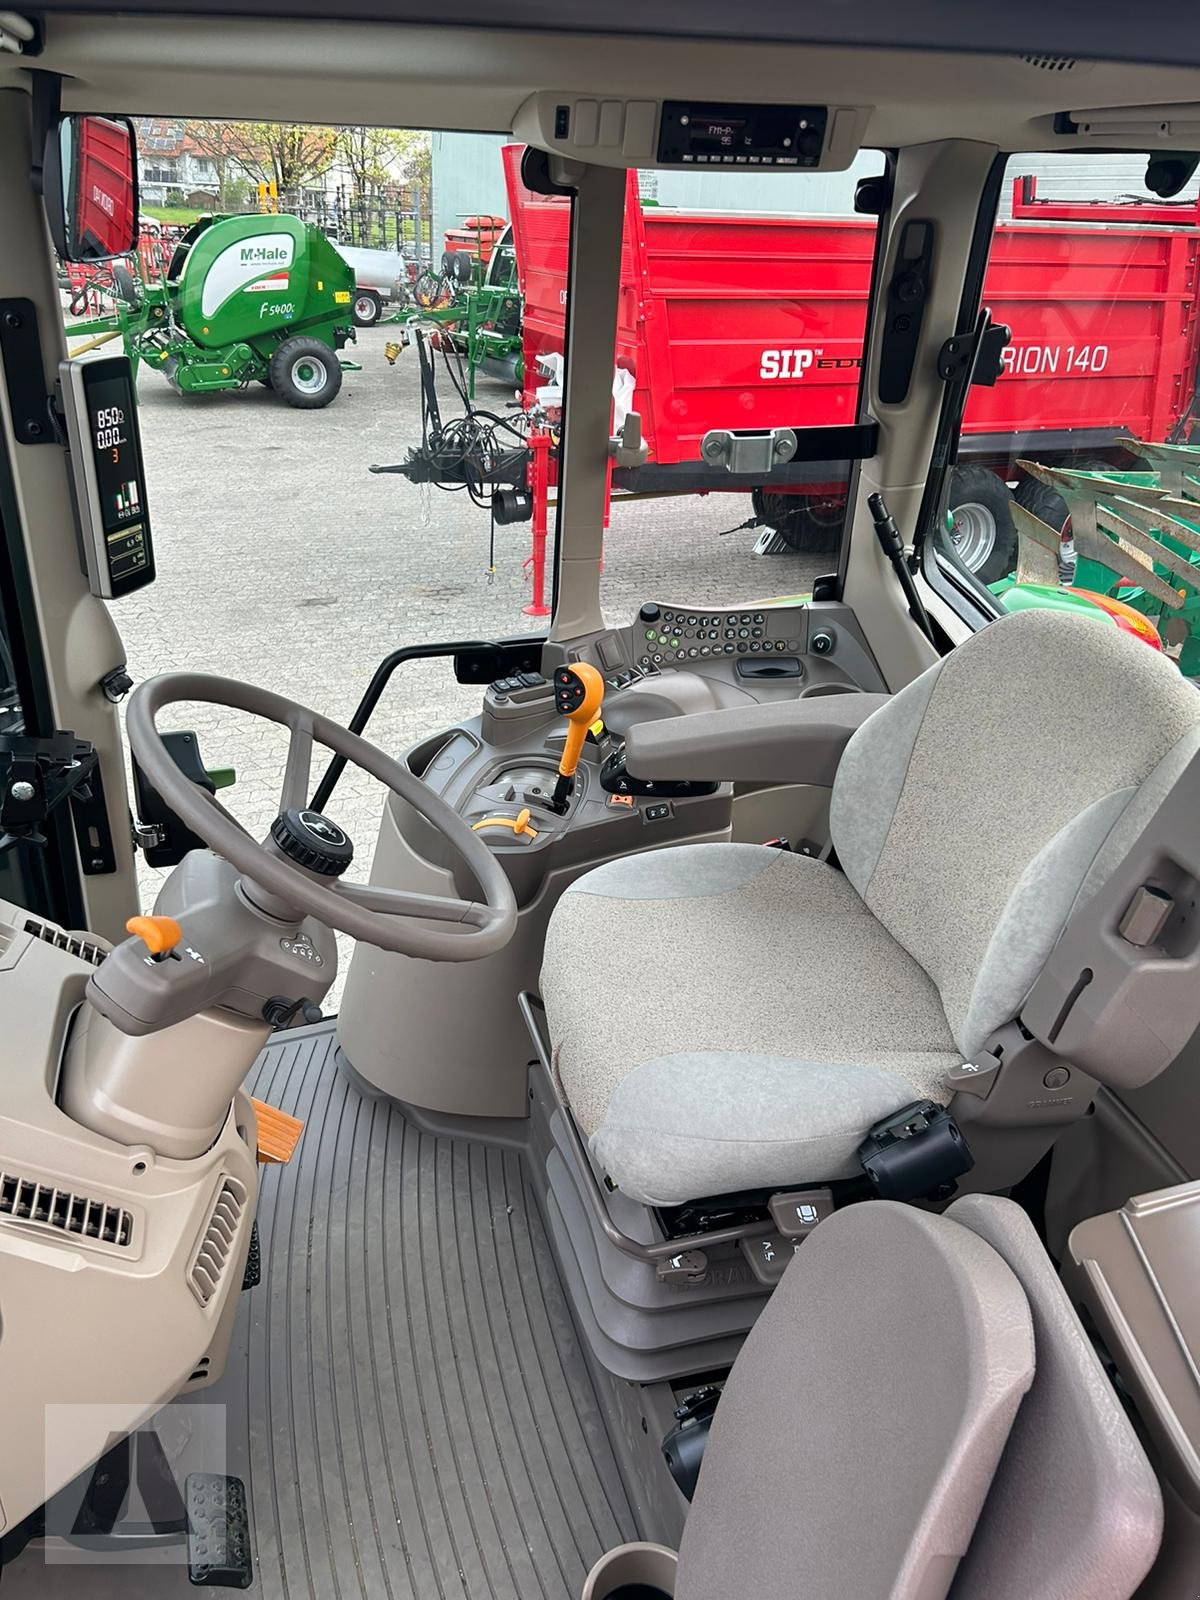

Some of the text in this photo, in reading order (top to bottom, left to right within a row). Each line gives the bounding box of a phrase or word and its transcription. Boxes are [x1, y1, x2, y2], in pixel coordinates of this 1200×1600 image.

[759, 349, 813, 379] SIP
[1065, 345, 1108, 372] 140
[112, 448, 119, 463] 3
